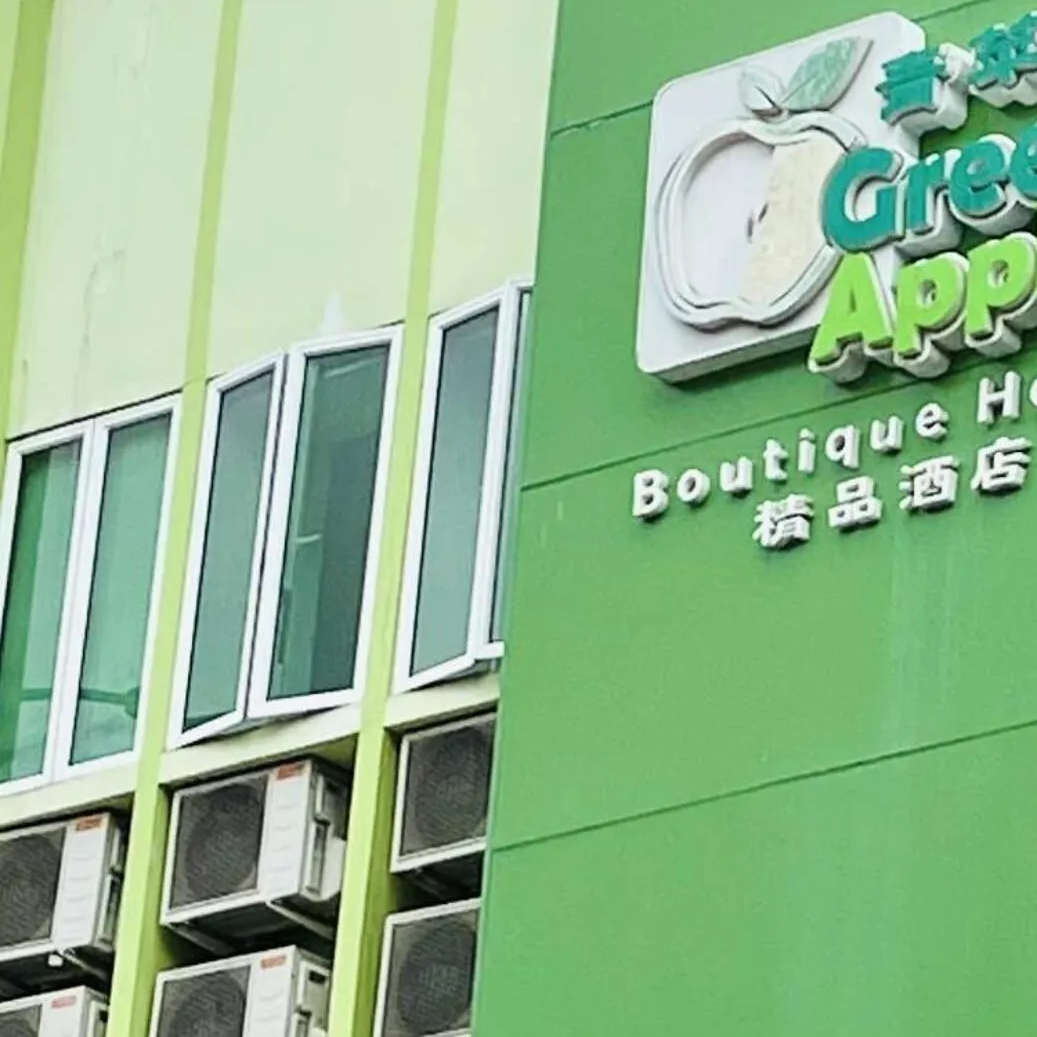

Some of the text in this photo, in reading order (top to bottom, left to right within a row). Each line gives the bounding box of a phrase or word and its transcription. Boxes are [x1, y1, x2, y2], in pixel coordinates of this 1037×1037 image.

[632, 402, 950, 519] Boutique
[753, 436, 1032, 549] 精品酒店
